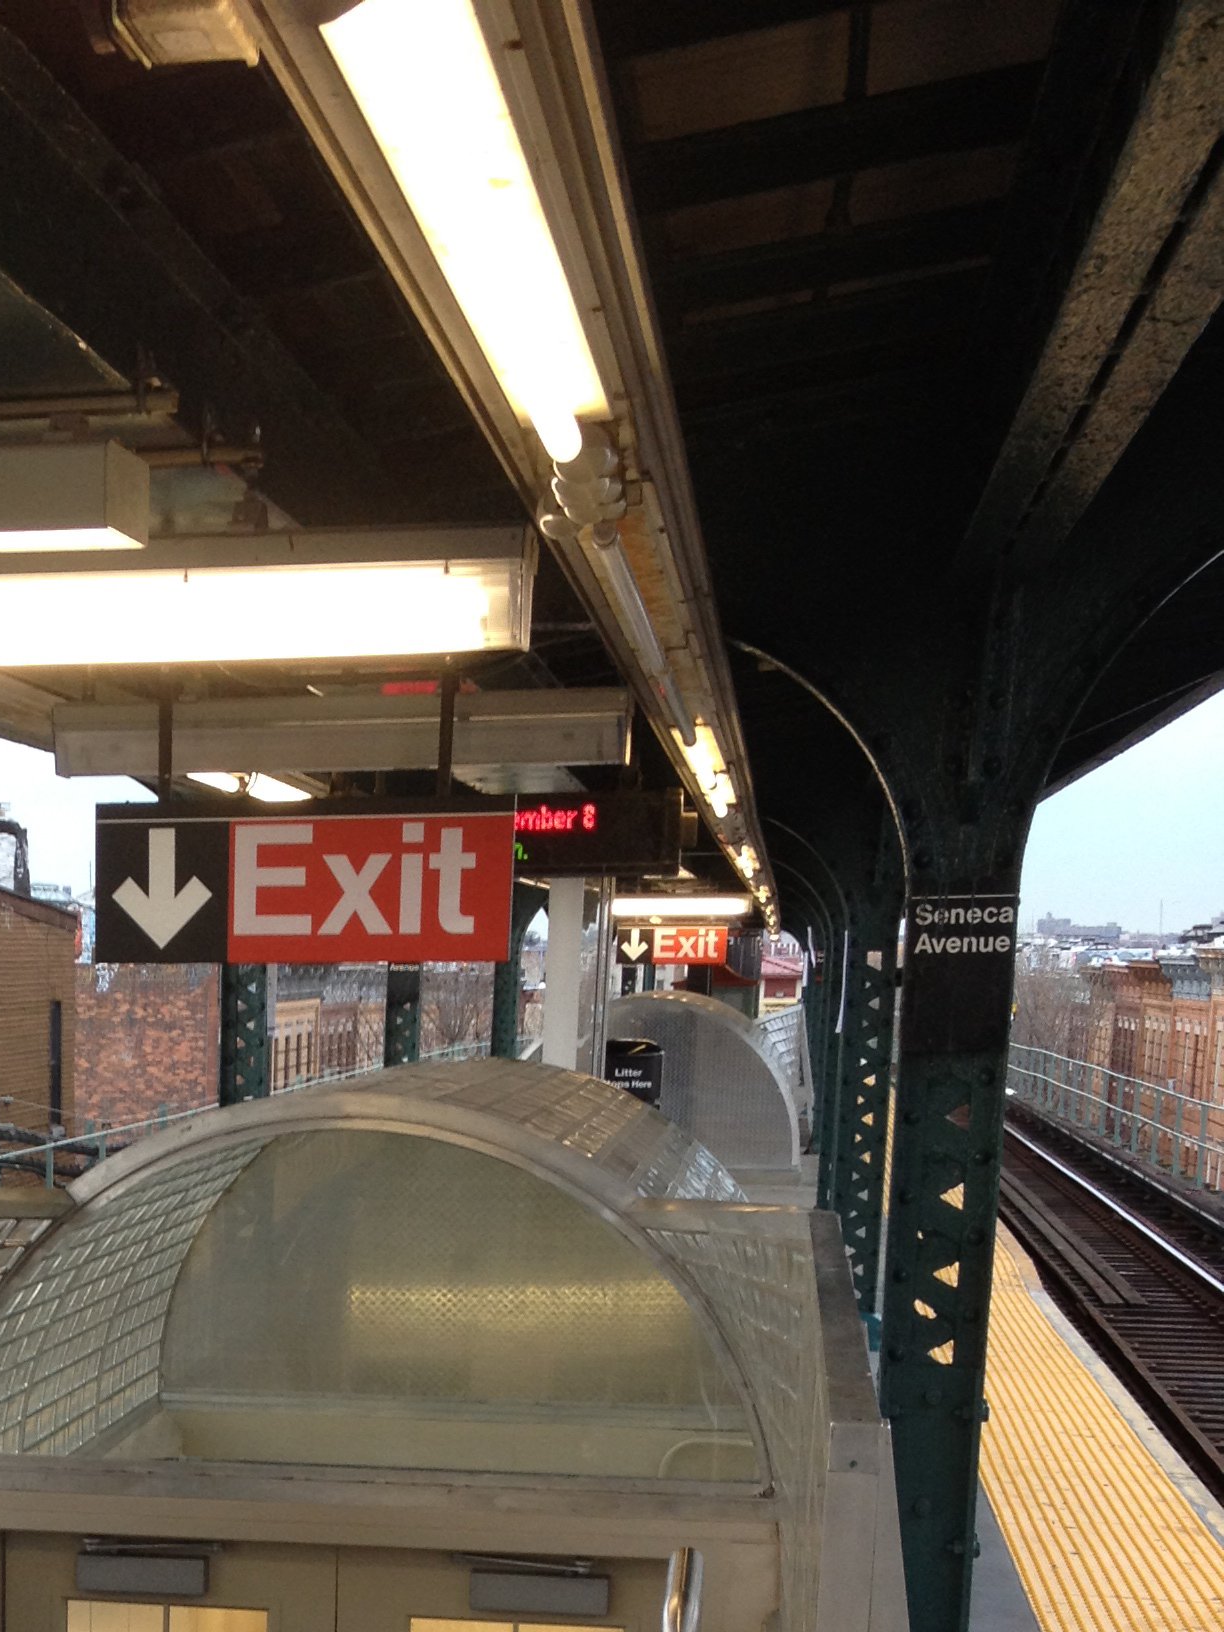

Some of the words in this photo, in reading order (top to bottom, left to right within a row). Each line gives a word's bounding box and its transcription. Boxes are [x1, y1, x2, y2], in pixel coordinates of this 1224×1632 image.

[233, 821, 476, 937] Exit
[916, 903, 1014, 926] Seneca
[653, 927, 719, 959] Exit
[914, 932, 1010, 954] Avenue
[614, 1067, 643, 1078] Litter
[631, 1080, 652, 1088] Here
